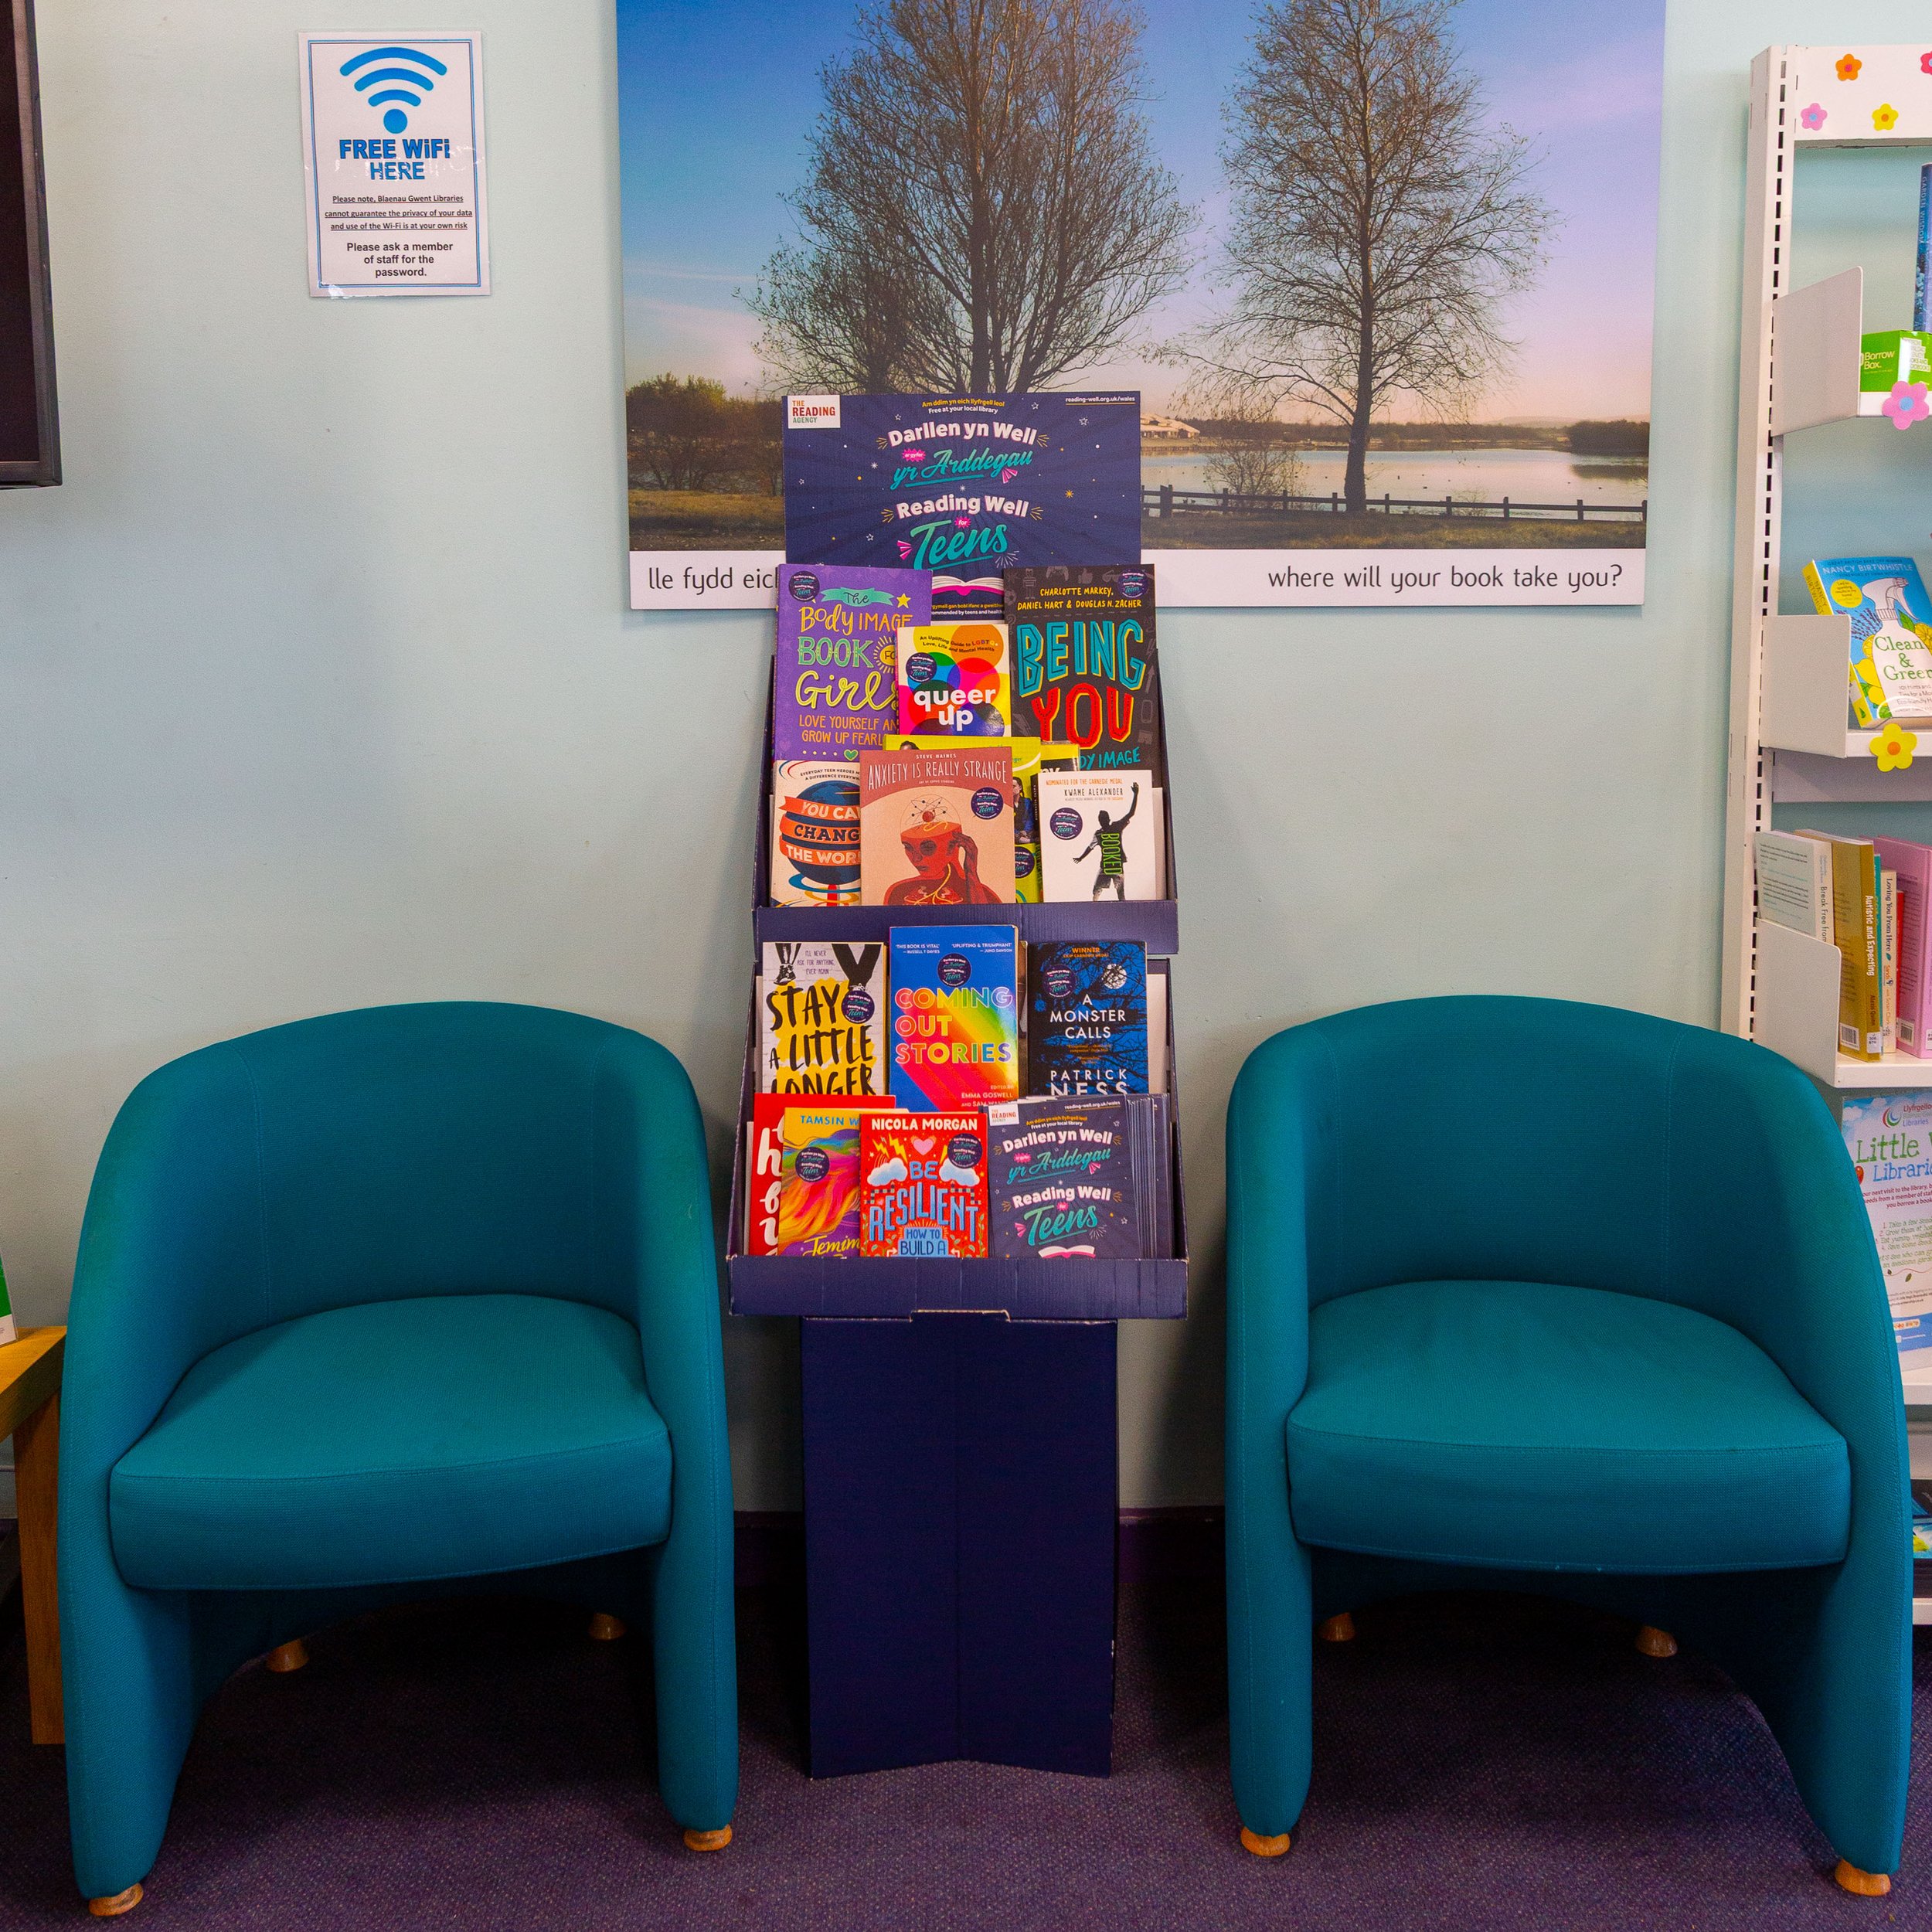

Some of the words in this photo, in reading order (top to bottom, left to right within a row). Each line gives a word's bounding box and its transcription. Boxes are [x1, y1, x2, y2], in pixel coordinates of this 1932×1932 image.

[339, 139, 396, 159] FREE
[403, 138, 451, 159] WiFi
[369, 162, 425, 180] HERE
[346, 243, 380, 251] Please
[383, 242, 400, 251] ask
[412, 243, 454, 251] member
[364, 255, 374, 264] of
[377, 255, 399, 264] staff
[401, 254, 415, 264] for
[418, 255, 434, 264] the
[375, 268, 427, 278] password.
[1864, 351, 1896, 361] Borrow
[792, 406, 836, 417] READING
[978, 406, 998, 414] library
[888, 421, 961, 447] Darllen
[963, 423, 989, 440] yn
[992, 421, 1038, 445] Well
[890, 468, 919, 491] yr
[921, 447, 1033, 478] Arddegau
[896, 494, 981, 519] Reading
[984, 495, 1029, 518] Well
[910, 519, 1009, 570] Teens
[1268, 566, 1334, 587] where
[1344, 566, 1380, 587] will
[1390, 570, 1441, 593] your
[1451, 566, 1504, 587] book
[1513, 565, 1558, 587] take
[1568, 563, 1623, 593] you?
[1822, 565, 1855, 574] NANCY
[1857, 563, 1914, 572] BIRTWHISTLE
[648, 567, 673, 590] lle
[683, 566, 733, 596] fydd
[743, 568, 779, 590] eic
[1039, 587, 1082, 596] CHARLOTTE
[1083, 587, 1114, 596] MARKEY,
[843, 591, 870, 605] The
[1017, 601, 1043, 611] DANIEL
[1044, 600, 1063, 609] HART
[1075, 600, 1106, 608] DOUGLAS
[1107, 600, 1114, 608] N.
[1114, 599, 1142, 608] ZACHER
[798, 603, 854, 636] Body
[798, 636, 874, 668] BOOK
[1874, 636, 1925, 652] Clean
[1016, 618, 1147, 698] BEING
[1899, 652, 1914, 668] &
[913, 689, 996, 713] queer
[798, 714, 826, 727] LOVE
[828, 716, 879, 730] YOURSELF
[938, 704, 974, 732] up
[1031, 682, 1134, 750] YOU
[801, 730, 831, 743] GROW
[835, 731, 850, 744] UP
[852, 733, 883, 746] FEARL
[1099, 747, 1141, 769] IMAGE
[868, 762, 909, 791] ANXIETY
[913, 762, 921, 779] IS
[926, 760, 959, 777] REALLY
[964, 760, 1007, 784] STRANGE
[1088, 787, 1124, 796] ALEXANDER
[801, 801, 829, 818] YOU
[794, 824, 860, 842] CHANG
[785, 844, 813, 864] THE
[817, 851, 861, 865] WOR
[1100, 833, 1123, 876] BOOKED
[1865, 895, 1874, 925] Autistic
[1866, 926, 1875, 940] and
[1866, 940, 1876, 977] Expecting
[765, 983, 841, 1032] STAY
[894, 986, 1013, 1010] COMING
[1082, 994, 1093, 1005] A
[894, 1015, 953, 1037] OUT
[1049, 1010, 1126, 1022] MONSTER
[1064, 1026, 1111, 1039] CALLS
[768, 1047, 781, 1070] A
[789, 1025, 873, 1072] LITTLE
[895, 1042, 1012, 1065] STORIES
[1050, 1069, 1128, 1081] PATRICK
[800, 1115, 845, 1126] TAMSIN
[871, 1118, 918, 1131] NICOLA
[922, 1118, 978, 1131] MORGAN
[1002, 1131, 1056, 1154] Darllen
[1057, 1130, 1077, 1143] yn
[1079, 1128, 1113, 1145] Well
[1855, 1132, 1920, 1163] Little
[909, 1161, 939, 1180] BE
[1006, 1166, 1026, 1185] yr
[1029, 1148, 1111, 1175] Arddegau
[1012, 1186, 1076, 1209] Reading
[1077, 1185, 1111, 1202] Well
[869, 1182, 979, 1242] RESILIENT
[906, 1229, 927, 1240] HOW
[930, 1229, 940, 1240] TO
[1023, 1205, 1098, 1247] Teens
[802, 1235, 860, 1257] Temim
[900, 1242, 934, 1256] BUILD
[937, 1242, 946, 1255] A
